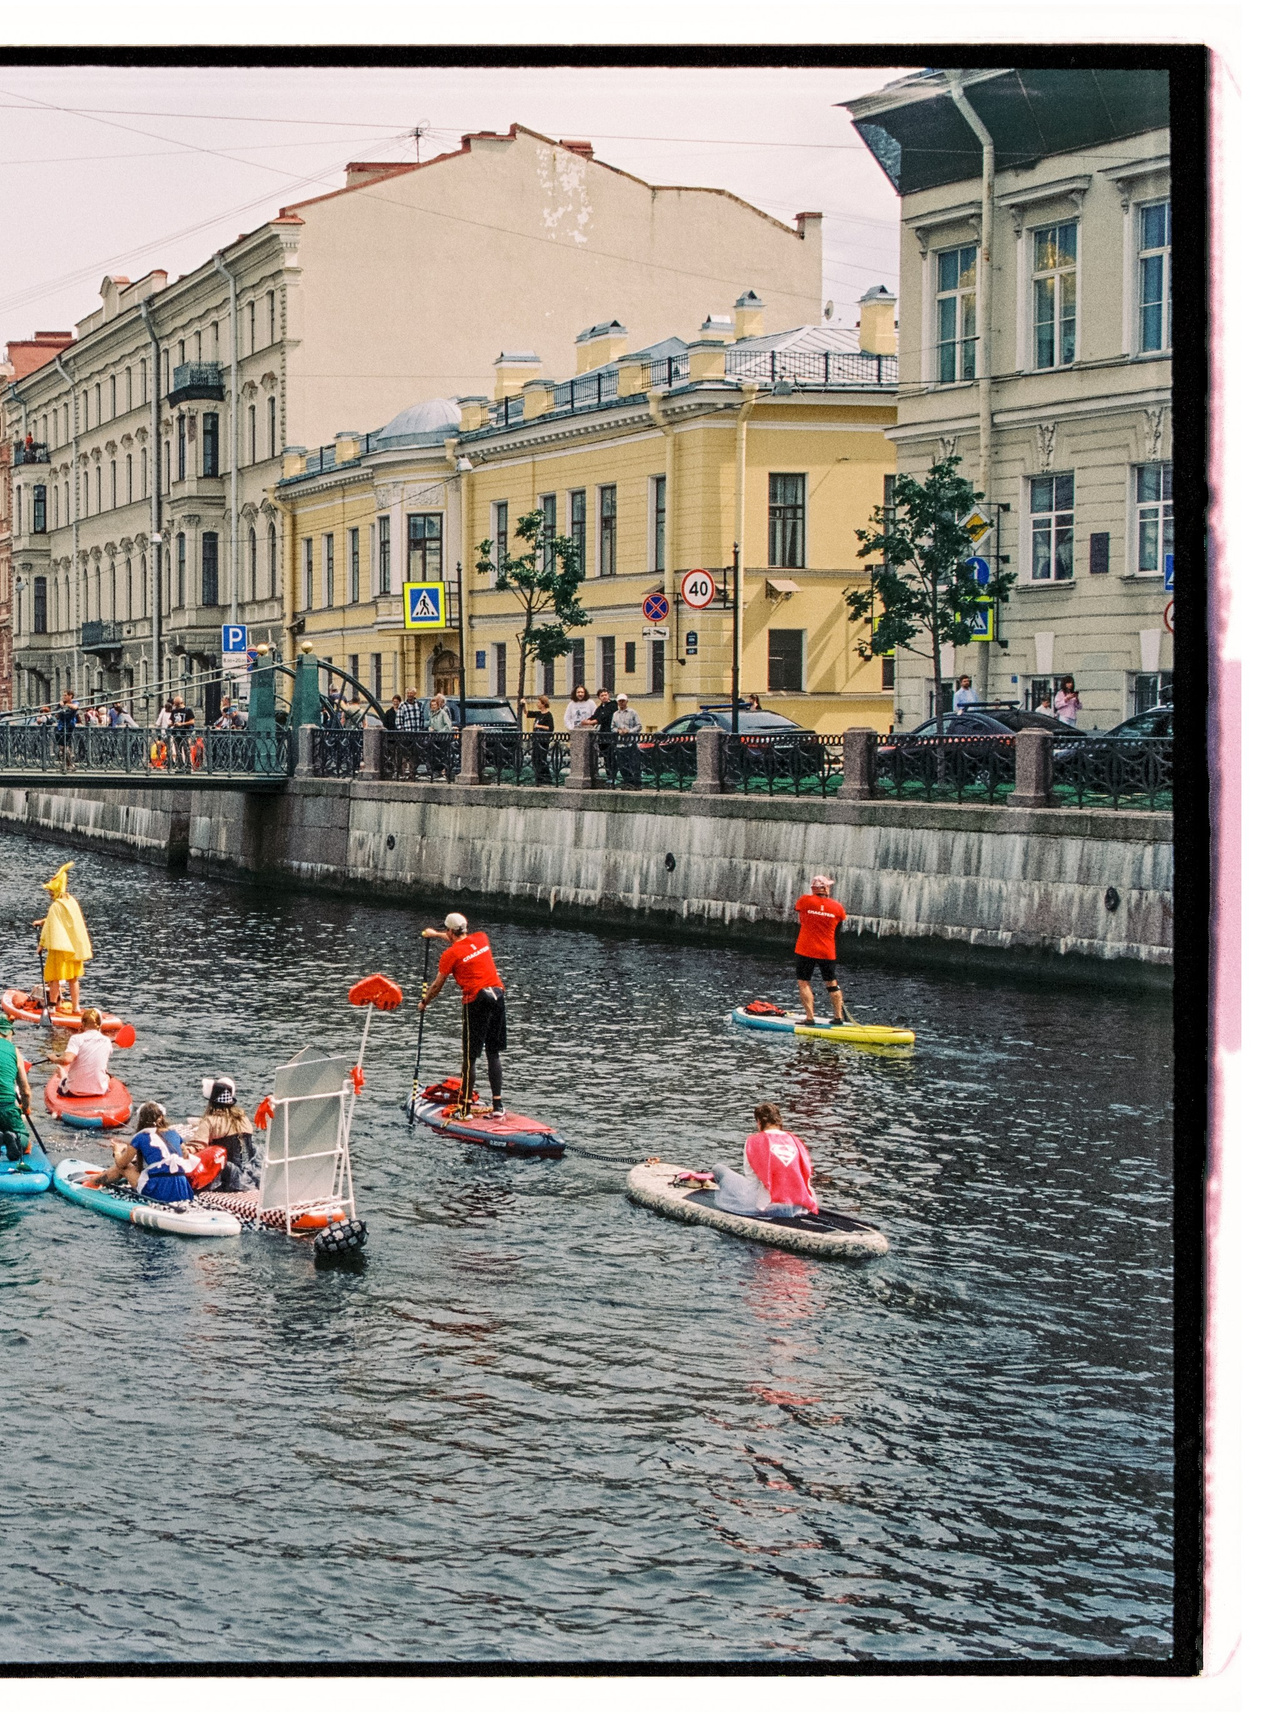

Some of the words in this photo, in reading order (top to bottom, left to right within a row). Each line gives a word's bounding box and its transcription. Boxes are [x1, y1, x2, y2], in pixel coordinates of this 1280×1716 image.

[689, 581, 708, 596] 40
[229, 627, 243, 650] P
[463, 946, 490, 962] СПАСАТЕ
